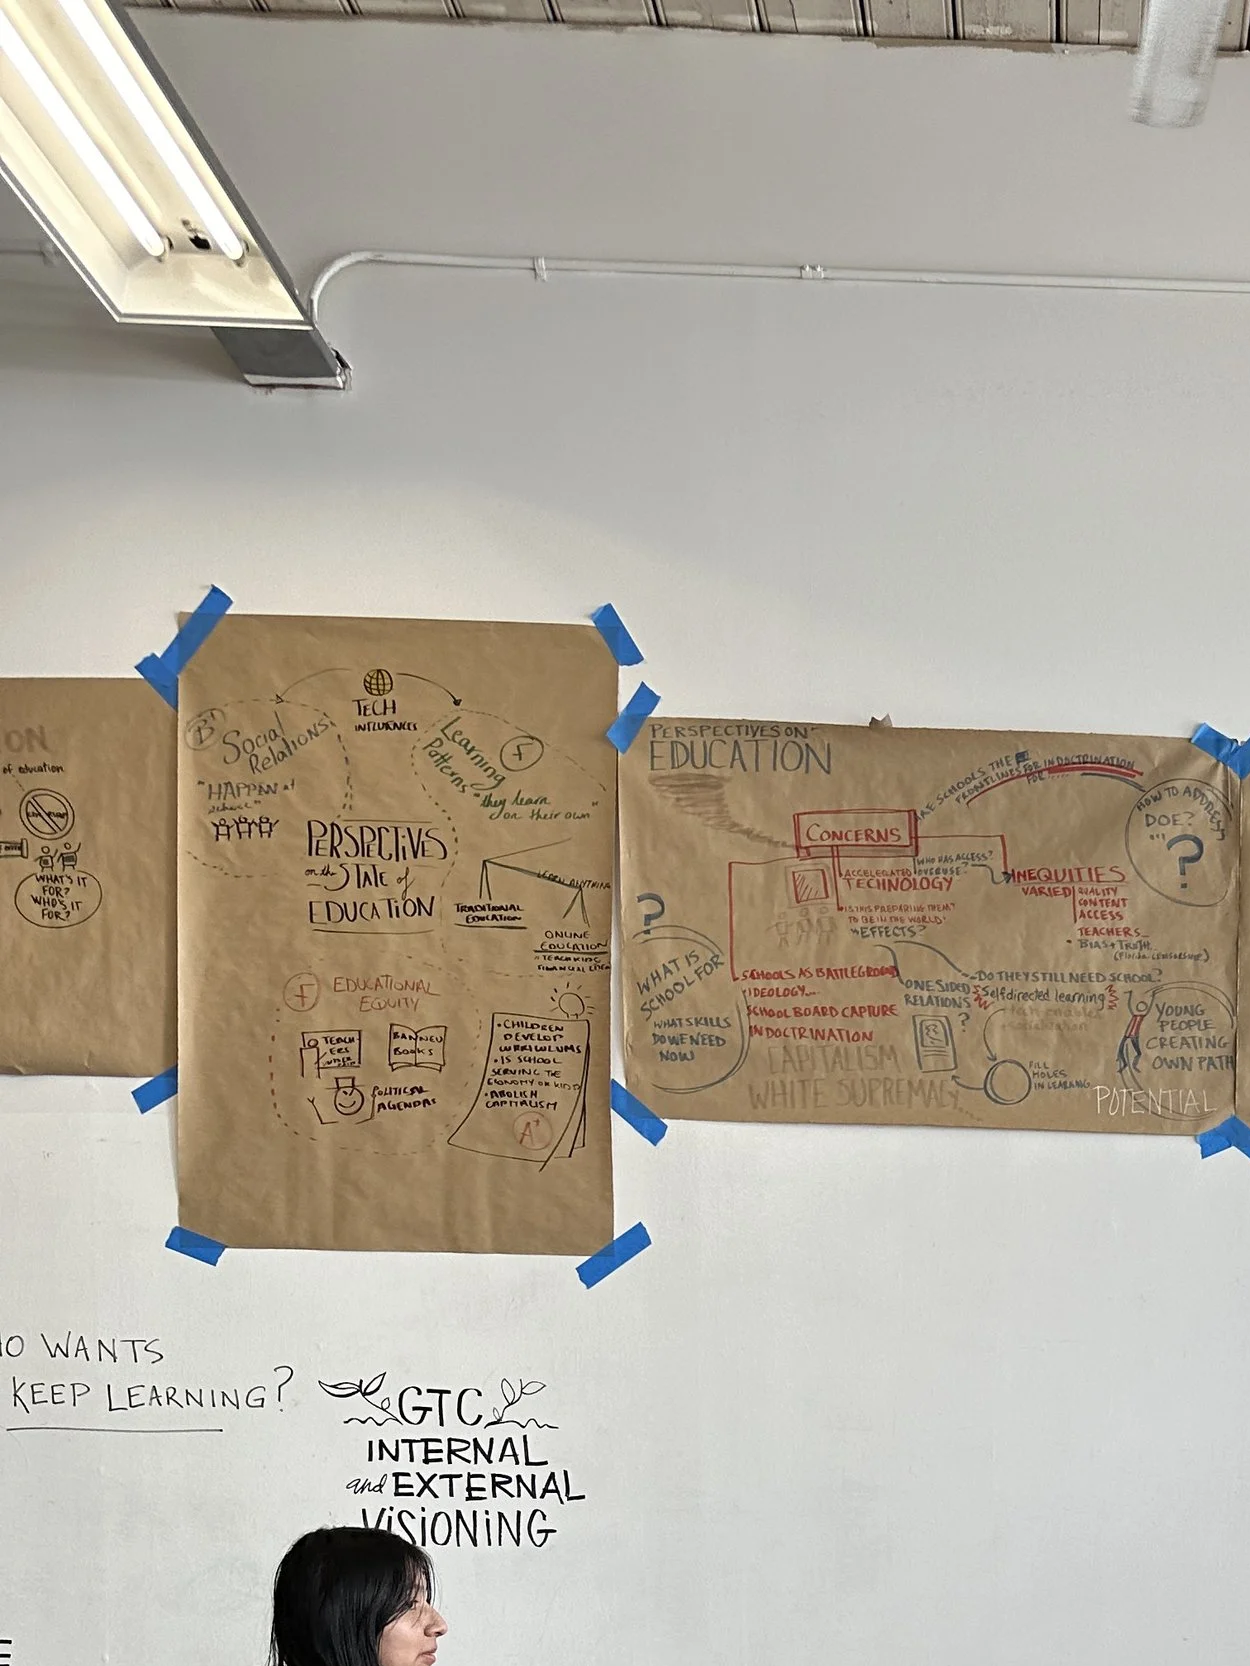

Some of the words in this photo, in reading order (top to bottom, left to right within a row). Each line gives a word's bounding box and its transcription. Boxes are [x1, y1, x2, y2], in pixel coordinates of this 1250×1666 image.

[352, 699, 397, 717] TECH
[222, 710, 285, 765] Social
[649, 723, 781, 739] PERSPECTIVES
[784, 726, 808, 738] ON
[440, 717, 506, 790] Learning
[650, 739, 832, 775] EDUCATION
[3, 764, 13, 774] of
[19, 762, 64, 773] education
[423, 738, 467, 794] Patterns
[936, 768, 986, 806] SCHOOLS
[511, 789, 550, 806] learn
[529, 809, 562, 820] their
[1145, 811, 1195, 828] DOE?
[307, 819, 448, 862] PERSPECTIVES
[806, 823, 901, 843] CONCERNS
[844, 868, 912, 877] ACCELERATED
[1011, 865, 1126, 883] INEQUITIES
[36, 874, 73, 884] WHAT'S
[77, 876, 88, 887] IT
[304, 868, 318, 876] on
[324, 862, 388, 891] STATE
[396, 866, 415, 900] of
[842, 876, 953, 892] TECHNOLOGY
[42, 885, 70, 897] FOR?
[1021, 886, 1072, 897] VARIED
[1078, 886, 1118, 897] QUALITY
[31, 895, 67, 910] WHO'S
[71, 901, 83, 911] IT
[309, 896, 435, 925] EDUCATION
[454, 903, 524, 912] TRADITIONAL
[1078, 898, 1129, 908] CONTENT
[41, 909, 71, 921] FOR?
[1078, 910, 1124, 921] ACCESS
[545, 930, 591, 939] ONLINE
[541, 940, 608, 951] EDUCATION
[636, 955, 682, 997] WHAT
[684, 950, 701, 966] IS
[741, 968, 795, 982] SCHOOLS
[798, 967, 813, 979] AS
[1030, 971, 1068, 982] STILL
[1069, 972, 1107, 983] NEED
[1109, 968, 1163, 982] SCHOOL?
[333, 975, 441, 996] EDUCATIONAL
[905, 979, 934, 991] ONE
[935, 980, 971, 994] SIDED
[360, 996, 420, 1012] EQUITY
[904, 994, 971, 1008] RELATIONS
[1055, 988, 1105, 1011] learning
[746, 1005, 791, 1019] SCHOOL
[792, 1004, 838, 1018] BOARD
[841, 1003, 898, 1018] CAPTURE
[1156, 1002, 1206, 1019] YOUNG
[503, 1020, 564, 1032] CHILDREN
[653, 1017, 684, 1030] WHAT
[685, 1016, 732, 1028] SKILLS
[1159, 1018, 1216, 1032] PEOPLE
[503, 1033, 565, 1041] DEVELOP
[689, 1033, 727, 1047] NEED
[748, 1025, 874, 1042] INDOCTRINATION
[1146, 1036, 1230, 1050] CREATING
[393, 1047, 433, 1056] BOOKS
[659, 1050, 695, 1062] NOW
[500, 1055, 511, 1064] IS
[517, 1055, 562, 1064] SCHOOL
[768, 1045, 899, 1074] CAPITALISM
[1152, 1055, 1192, 1071] OWN
[1195, 1055, 1235, 1071] PATH
[491, 1068, 540, 1076] SERVING
[1033, 1071, 1067, 1079] HOLES
[372, 1085, 429, 1096] POLITICAL
[490, 1090, 537, 1098] ABOLISH
[749, 1077, 827, 1110] WHITE
[377, 1098, 437, 1112] AGENDAS
[485, 1101, 558, 1110] CAPITALISM
[1092, 1085, 1218, 1117] POTENTIAL
[41, 1331, 163, 1363] WANTS
[13, 1376, 90, 1413] KEEP
[107, 1365, 293, 1412] LEARNING?
[398, 1386, 483, 1427] GTC
[368, 1435, 548, 1466] INTERNAL
[346, 1474, 387, 1495] and
[392, 1470, 585, 1504] EXTERNAL
